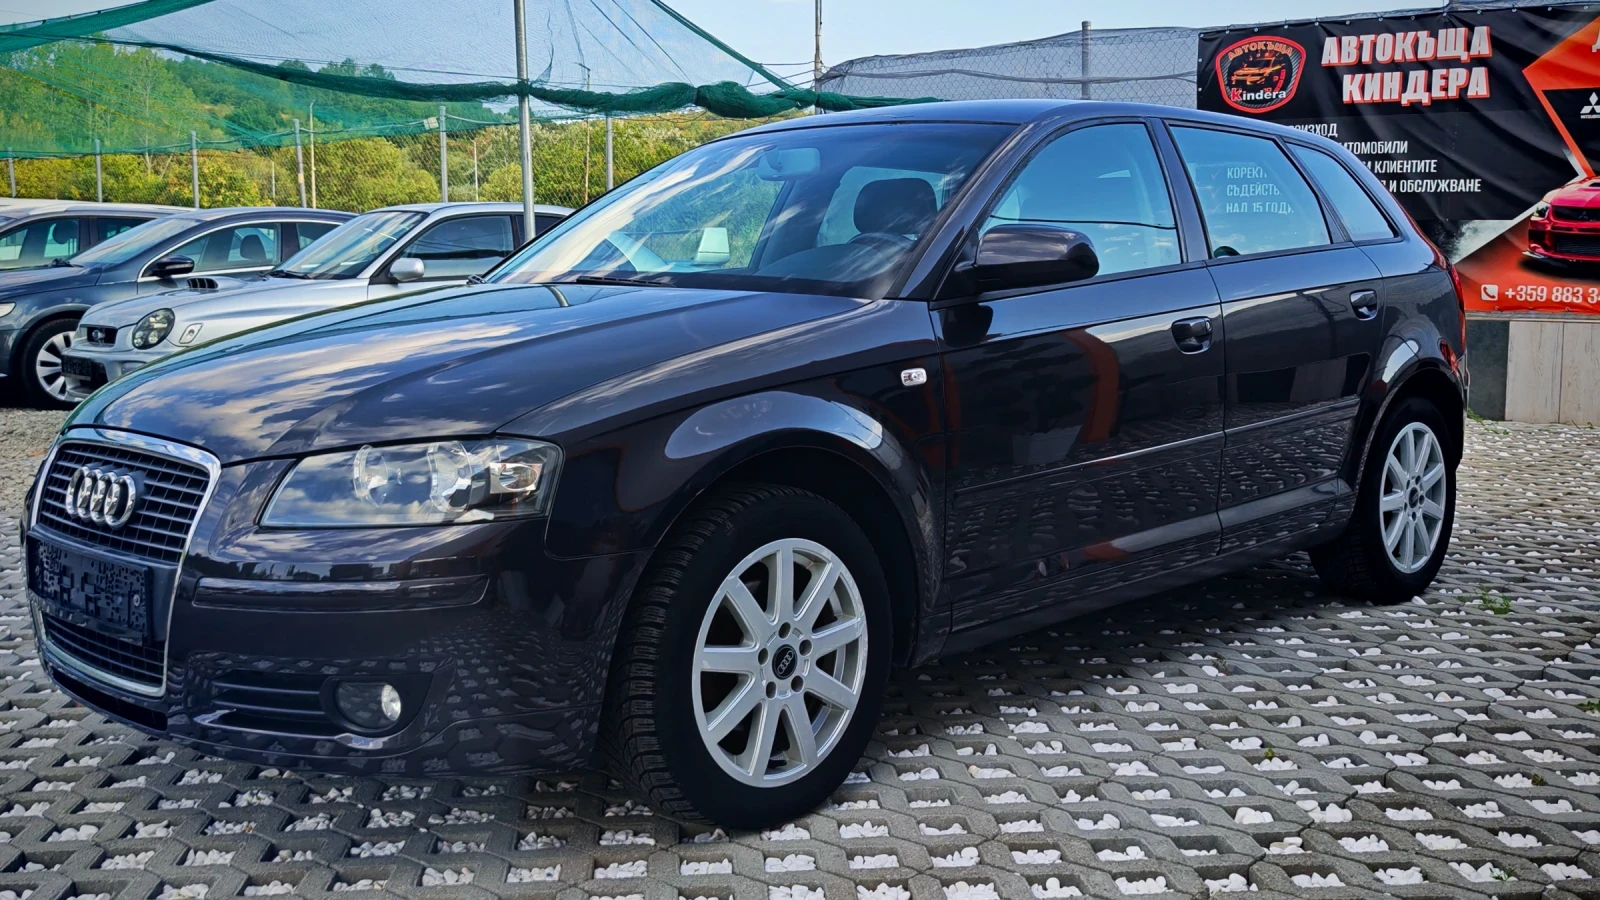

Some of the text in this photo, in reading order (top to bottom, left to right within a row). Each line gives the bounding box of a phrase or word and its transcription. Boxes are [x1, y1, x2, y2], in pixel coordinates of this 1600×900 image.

[1228, 41, 1293, 60] АВТОКЪЩА
[1321, 26, 1492, 67] АВТОКЪЩА
[1342, 67, 1490, 106] КИНДЕРА
[1230, 88, 1287, 101] Kindera
[1339, 140, 1408, 155] ТОМОБИЛИ
[1374, 159, 1438, 174] КЛИЕНТИТЕ
[1389, 180, 1397, 193] И
[1399, 178, 1482, 193] ОБСЛУЖВАНЕ
[1251, 202, 1263, 213] 15
[1504, 285, 1600, 304] +359 883 3
